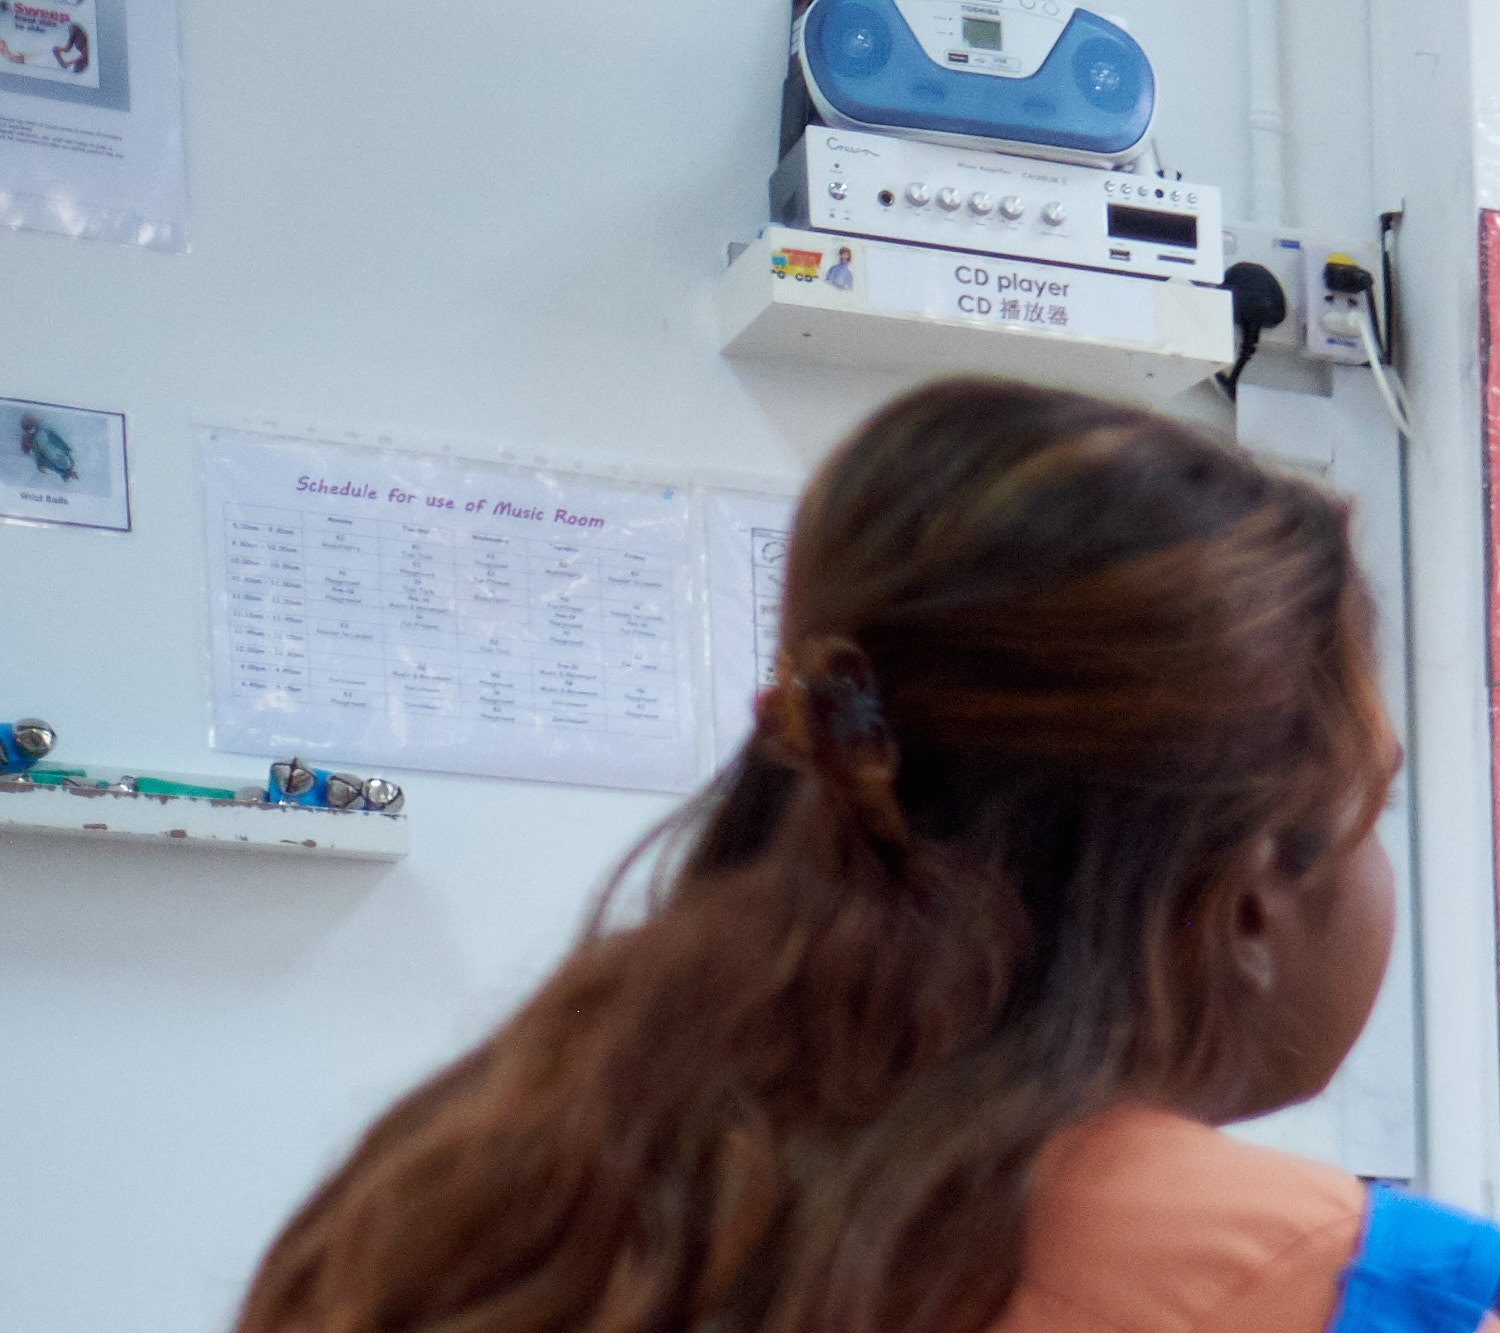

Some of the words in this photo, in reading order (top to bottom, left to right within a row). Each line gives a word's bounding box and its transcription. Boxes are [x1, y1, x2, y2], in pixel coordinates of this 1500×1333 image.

[955, 265, 989, 286] CD
[998, 272, 1070, 298] player
[958, 294, 992, 315] CD
[1000, 297, 1069, 326] 播放器
[296, 475, 378, 501] Schedule
[388, 487, 416, 504] for
[427, 496, 455, 510] use
[465, 499, 488, 513] of
[493, 501, 544, 522] Music
[554, 508, 606, 529] Room
